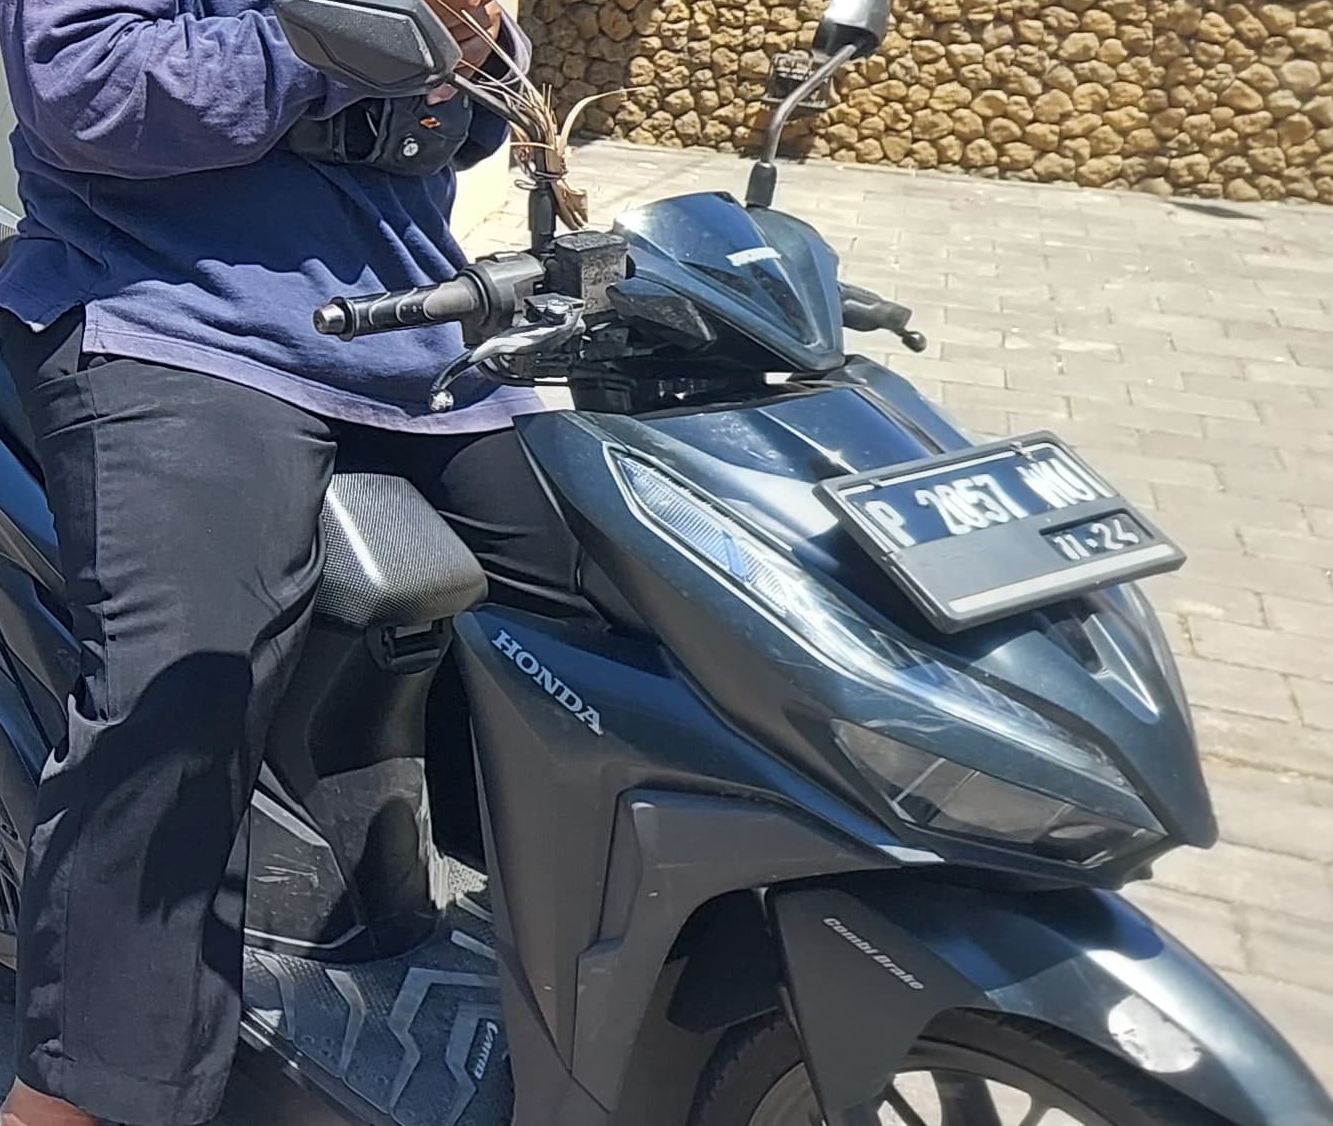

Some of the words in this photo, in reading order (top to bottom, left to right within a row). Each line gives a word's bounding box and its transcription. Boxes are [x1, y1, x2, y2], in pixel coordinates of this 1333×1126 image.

[863, 500, 917, 548] P
[914, 473, 1030, 536] 2057
[492, 629, 604, 735] HONDA
[823, 917, 879, 954] Combi
